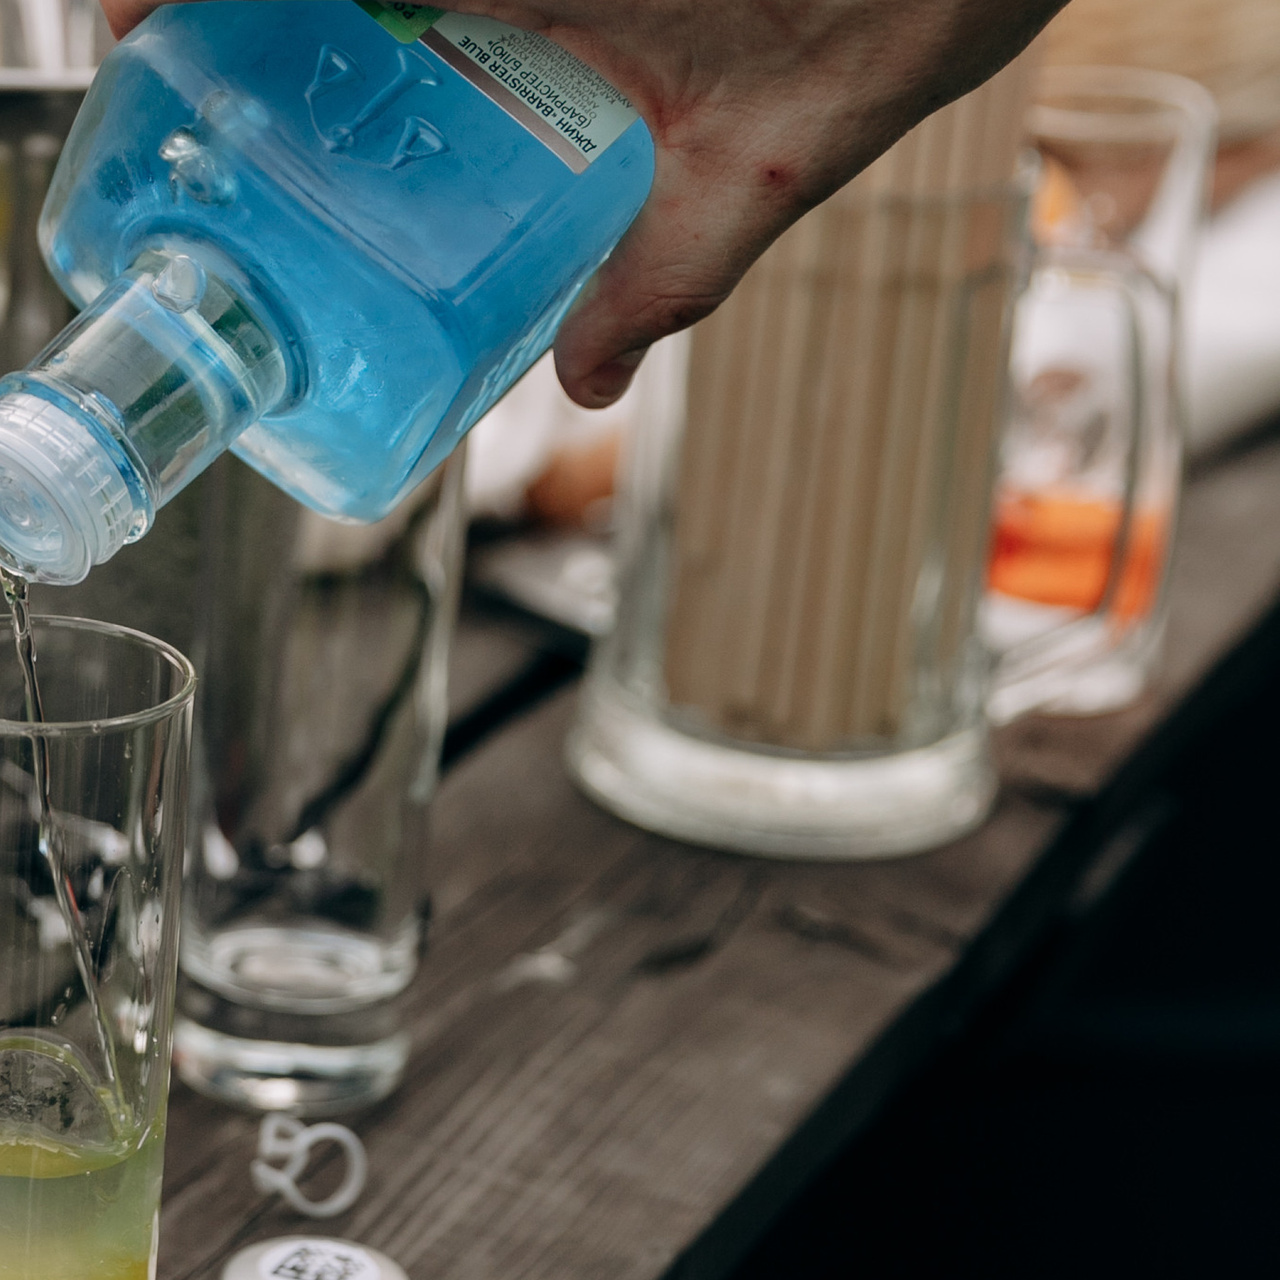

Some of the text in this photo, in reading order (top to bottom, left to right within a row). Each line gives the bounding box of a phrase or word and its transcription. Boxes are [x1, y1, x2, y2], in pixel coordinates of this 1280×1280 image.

[457, 34, 597, 155] ДЖИН «BARRISTER BLUE
[484, 36, 592, 131] (БАРРИСТЕР БЛЮ)»
[497, 33, 597, 121] ОРИГИНАЛЬНЫЙ КУПАЖ
[507, 31, 599, 111] АРОМАТНЫХ СПИРТОВ
[520, 31, 597, 99] МОЖЖЕВЕЛЬНИКА,
[557, 53, 566, 62] И
[565, 59, 616, 104] КАРДАМОНА
